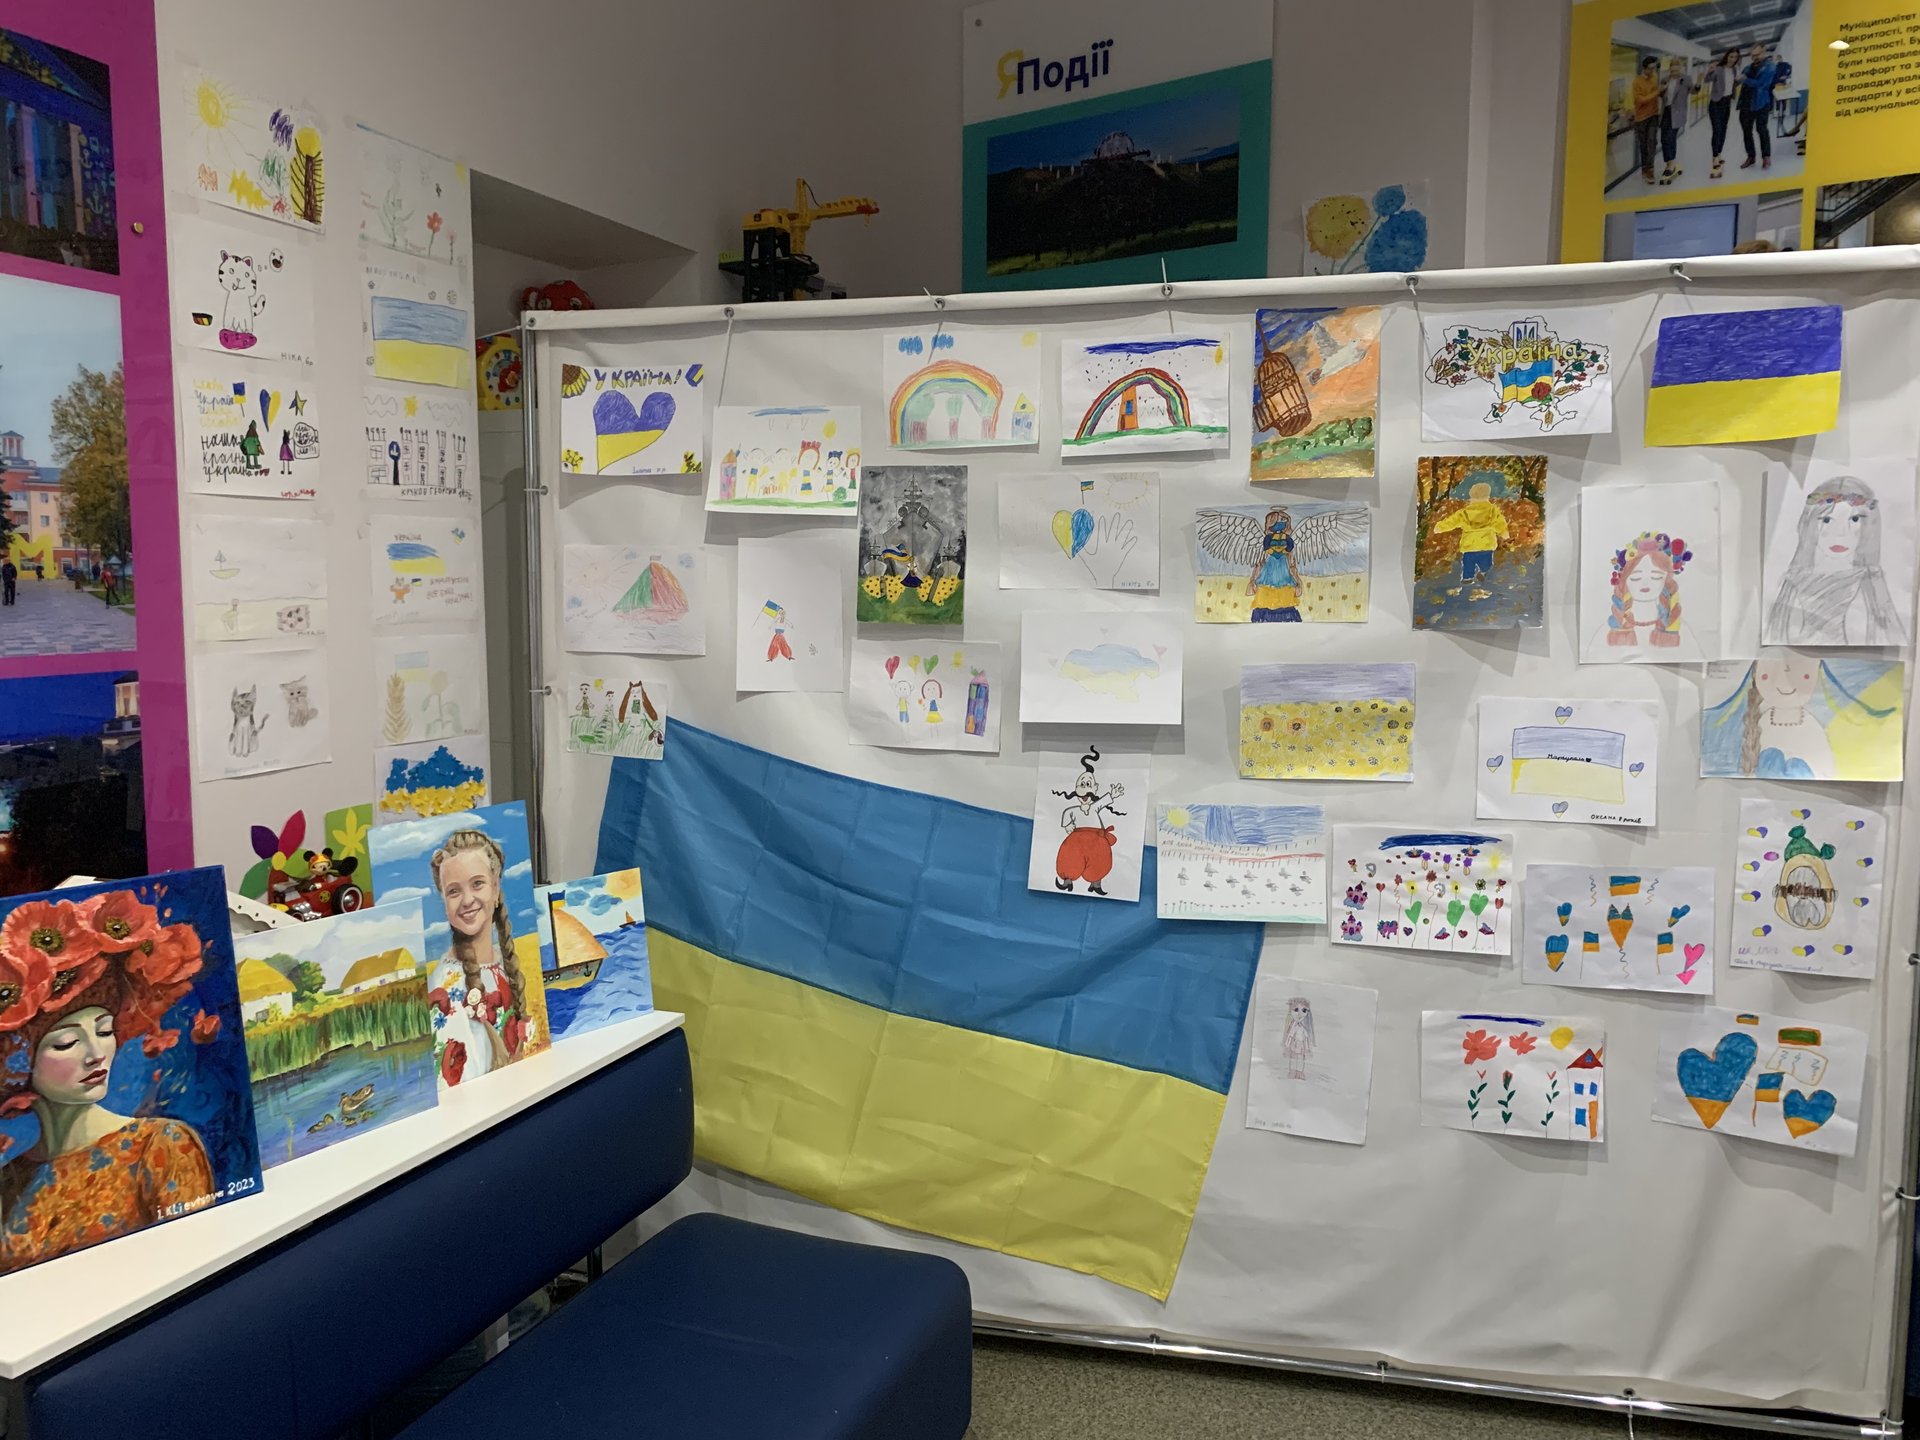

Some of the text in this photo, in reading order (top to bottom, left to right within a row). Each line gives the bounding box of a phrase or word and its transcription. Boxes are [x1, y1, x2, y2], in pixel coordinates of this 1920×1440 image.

[1840, 13, 1916, 32] Муніципалітет
[1840, 28, 1902, 44] ідкритості,
[1838, 38, 1905, 58] доступності.
[1837, 72, 1846, 81] їх
[1849, 65, 1897, 79] комфорт
[1900, 62, 1912, 71] та
[1838, 59, 1863, 69] були
[1836, 90, 1893, 105] стандарти
[1896, 88, 1902, 97] у
[1835, 107, 1852, 117] від
[227, 1177, 255, 1196] 2023
